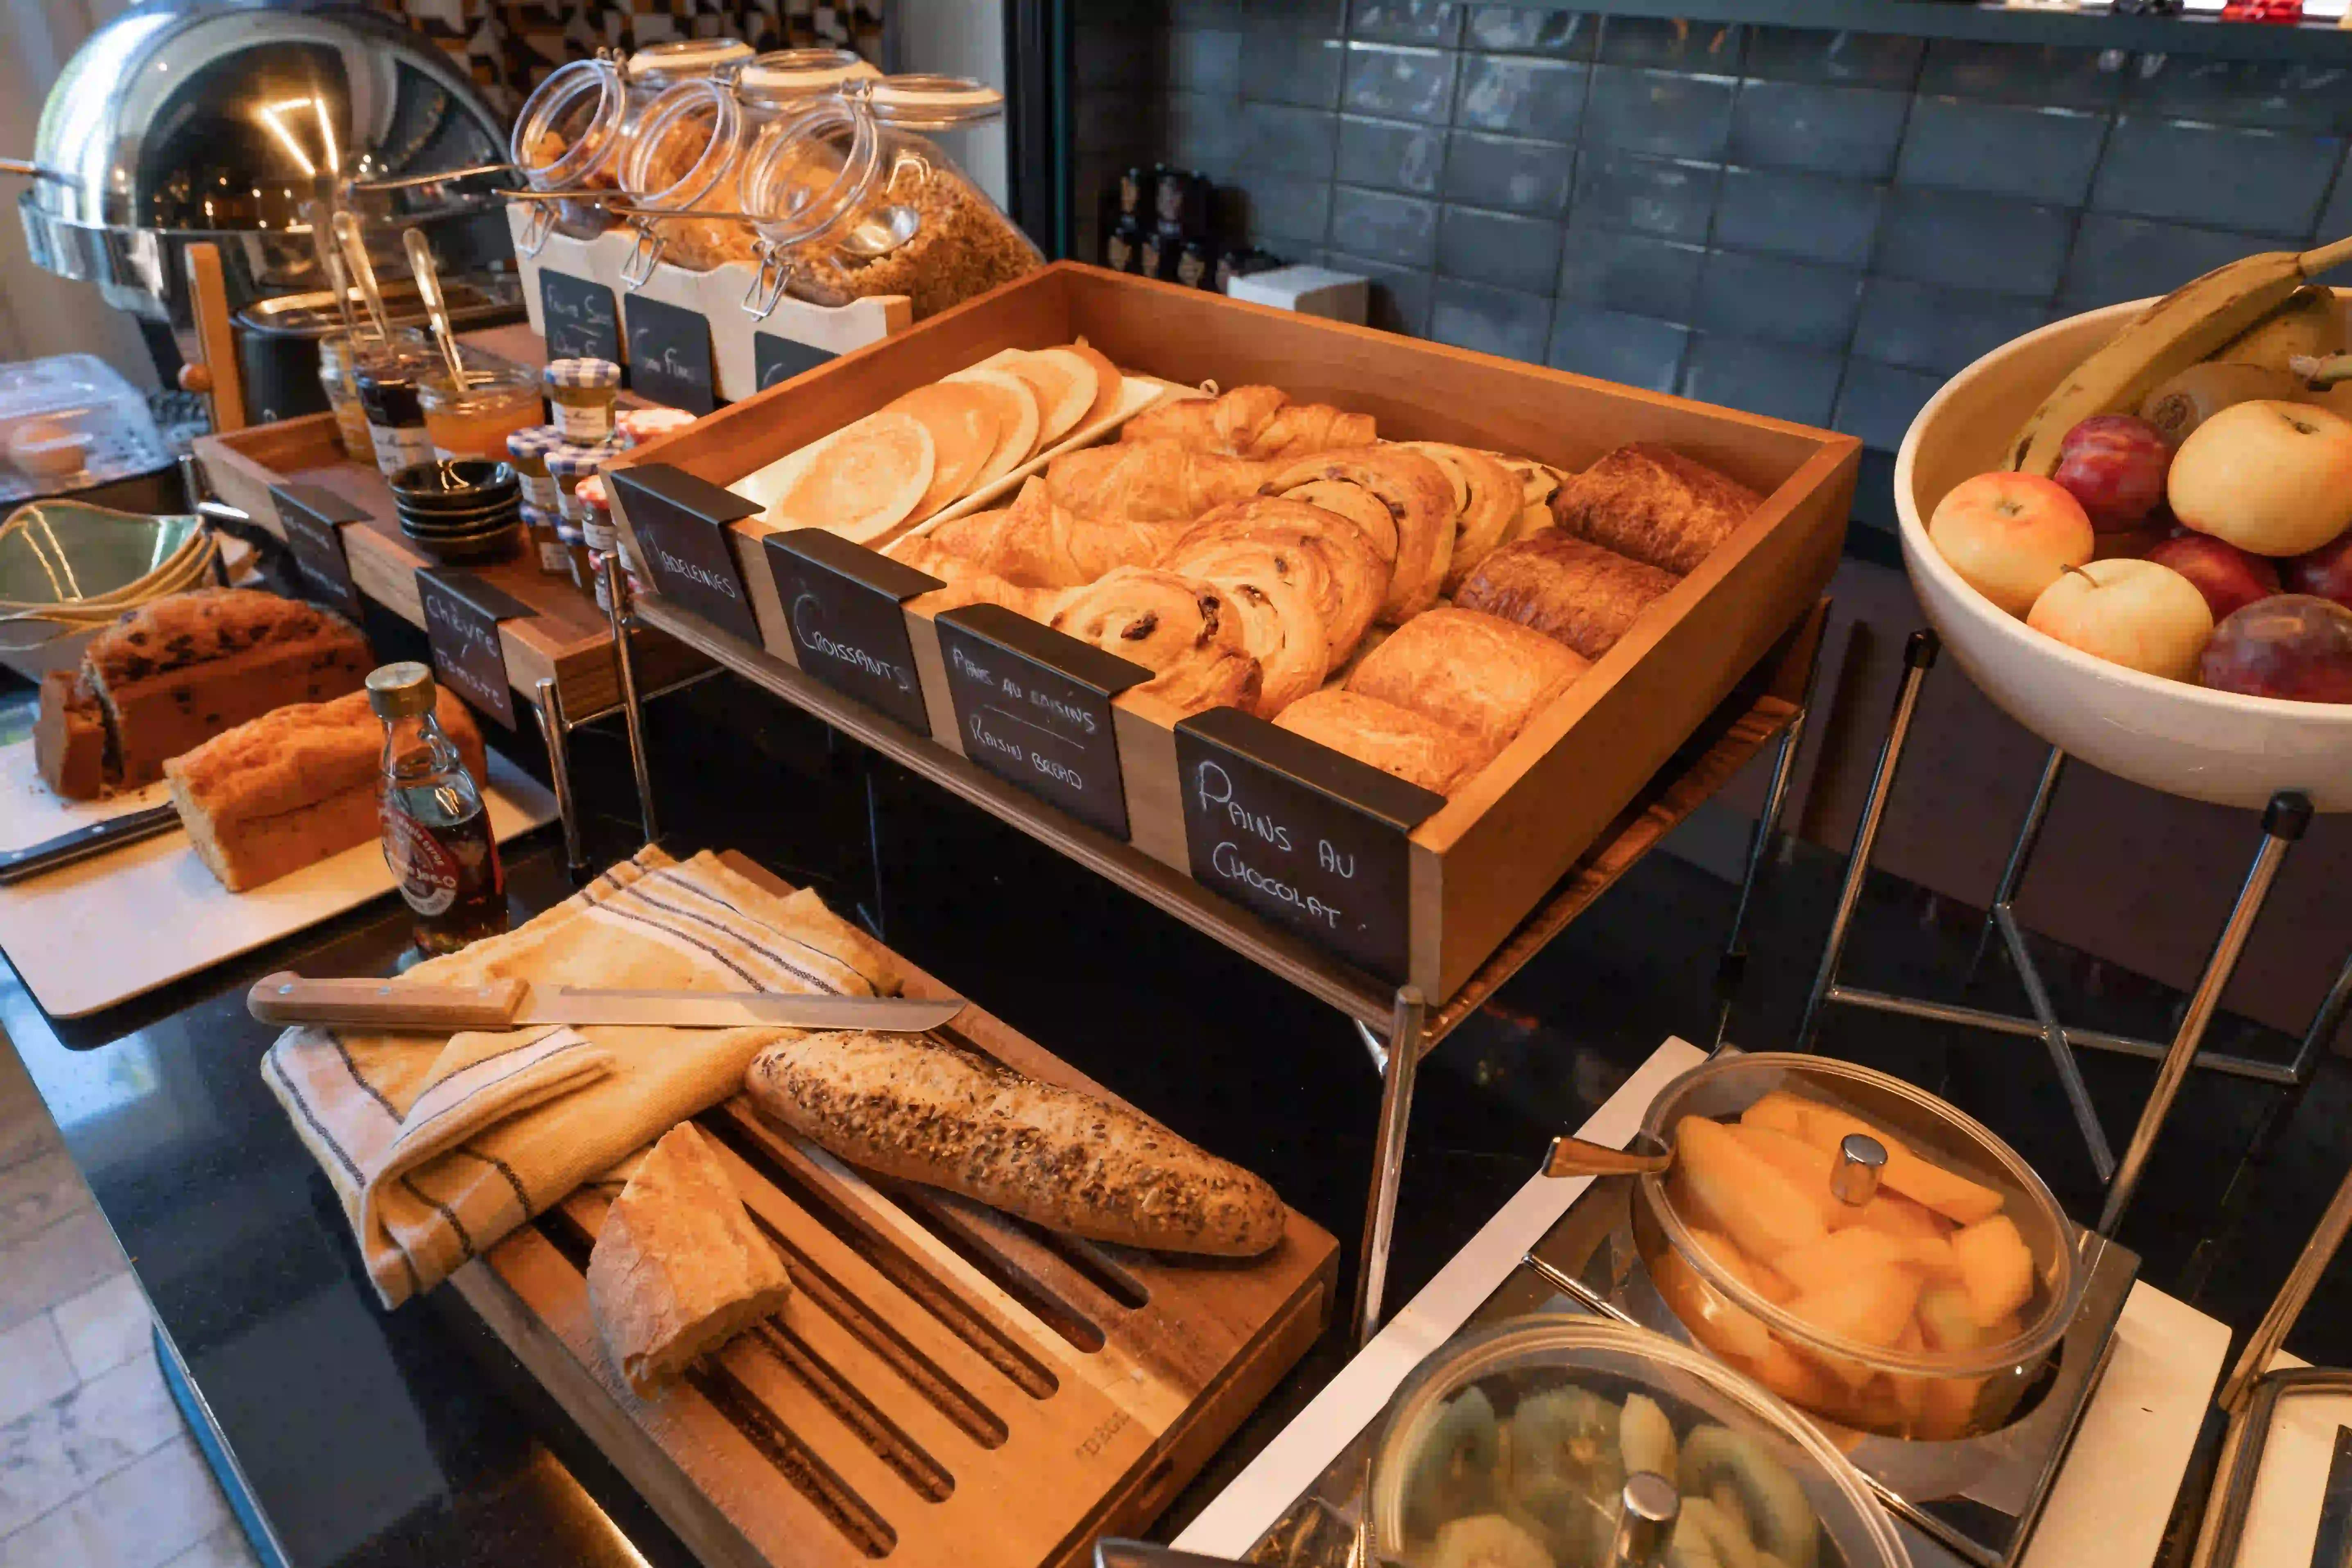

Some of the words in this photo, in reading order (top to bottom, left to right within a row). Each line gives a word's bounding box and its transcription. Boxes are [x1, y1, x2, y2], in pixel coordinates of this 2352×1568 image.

[1032, 752, 1082, 790] BREAD
[1198, 760, 1291, 852] PAINS
[1319, 839, 1354, 878] AU
[1213, 842, 1340, 929] CHOCOLAT
